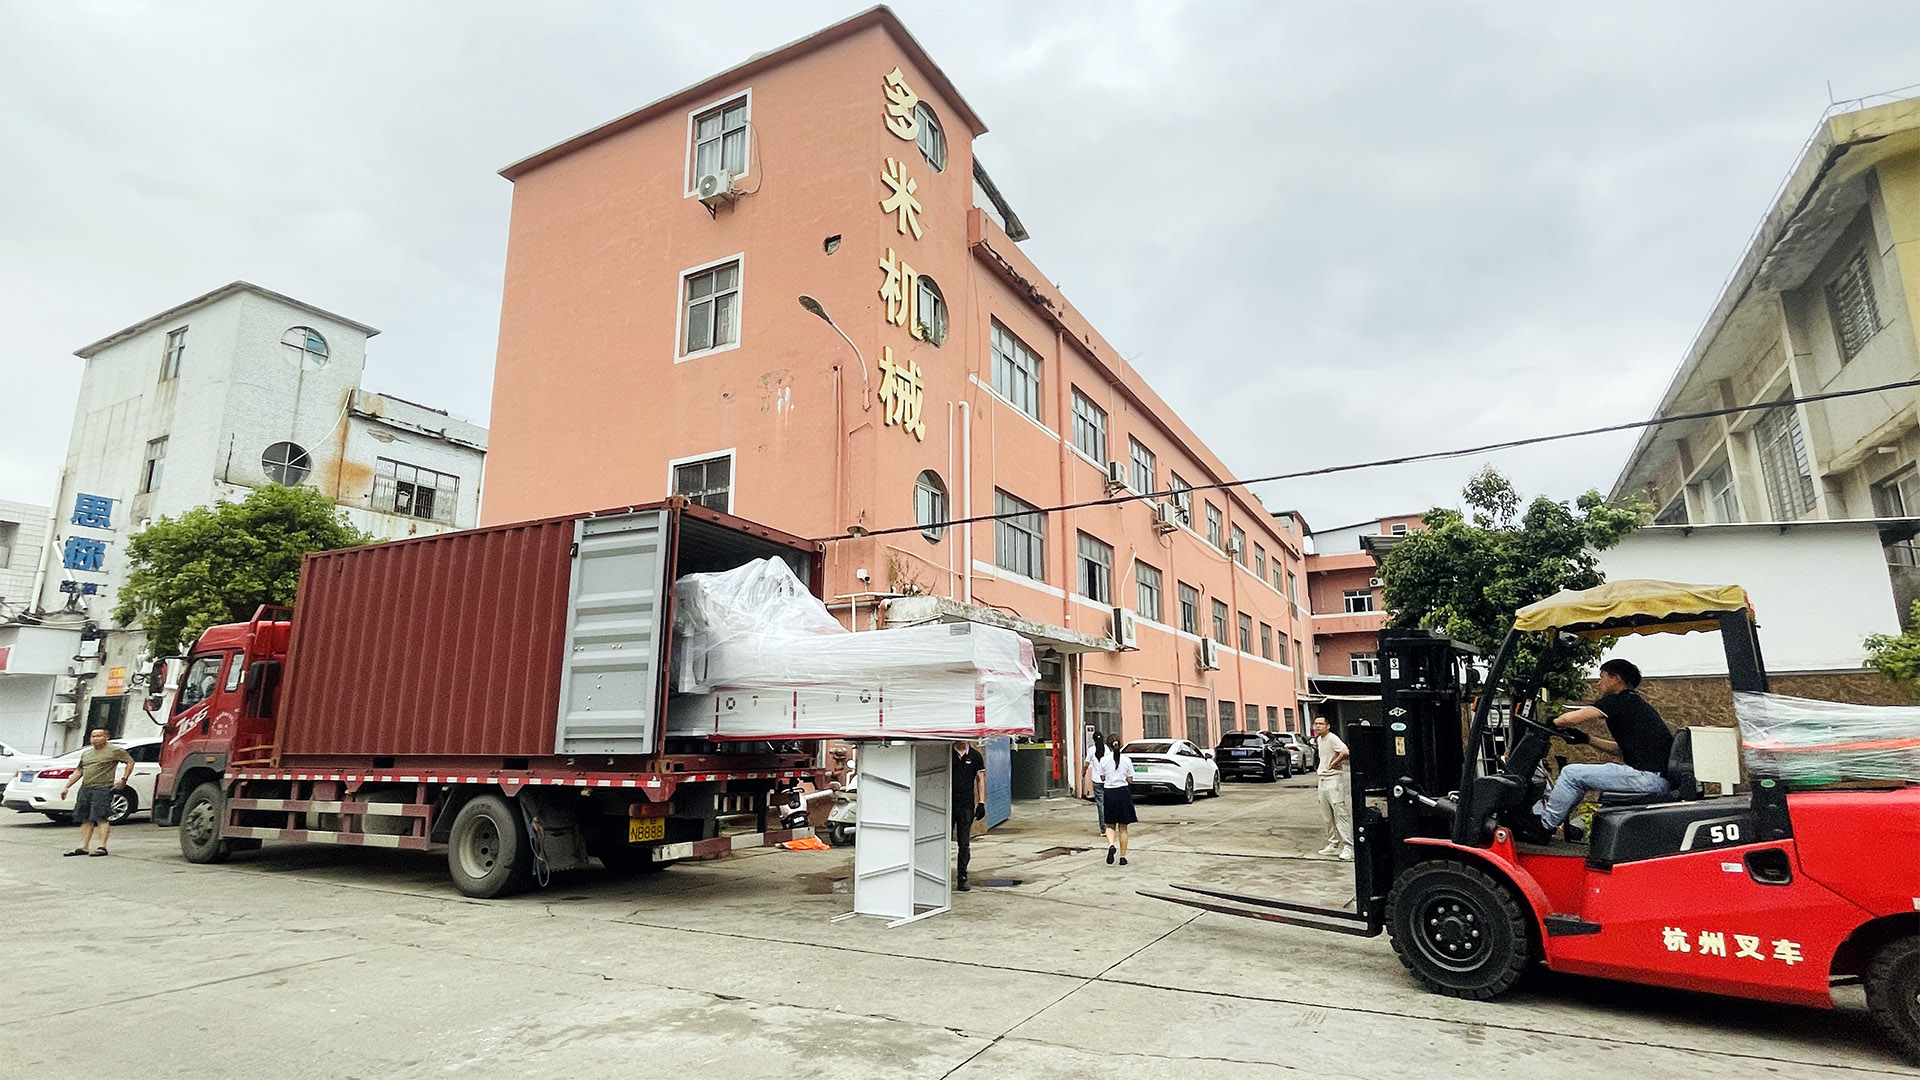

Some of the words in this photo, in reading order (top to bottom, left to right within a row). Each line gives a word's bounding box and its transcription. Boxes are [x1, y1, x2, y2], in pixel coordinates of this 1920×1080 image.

[878, 67, 926, 441] 多米机械
[1710, 823, 1740, 843] 50
[1662, 926, 1804, 966] 杭州叉车
